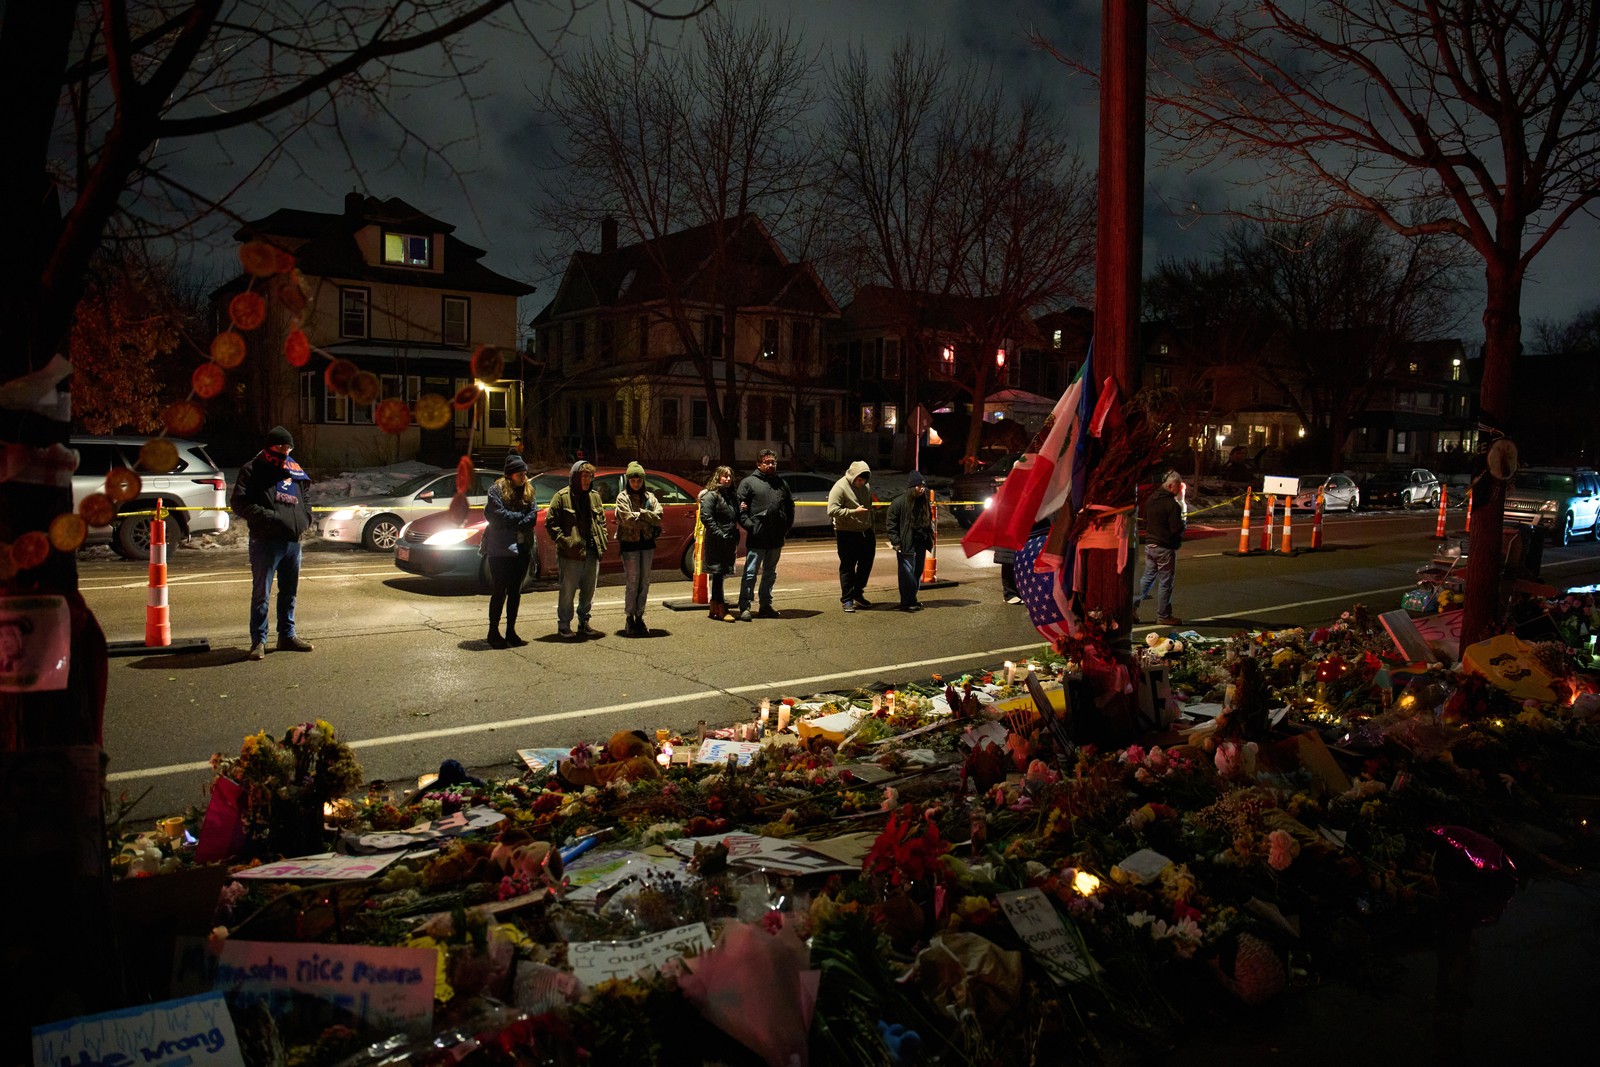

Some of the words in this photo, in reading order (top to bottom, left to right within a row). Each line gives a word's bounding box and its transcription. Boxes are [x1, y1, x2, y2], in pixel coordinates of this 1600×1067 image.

[1005, 895, 1042, 916] REST
[1024, 913, 1042, 925] IN
[574, 943, 625, 953] GET
[628, 931, 668, 949] OUT
[676, 925, 700, 936] OF
[296, 953, 344, 983] nice
[608, 952, 647, 965] OUR
[140, 1027, 225, 1063] wrong
